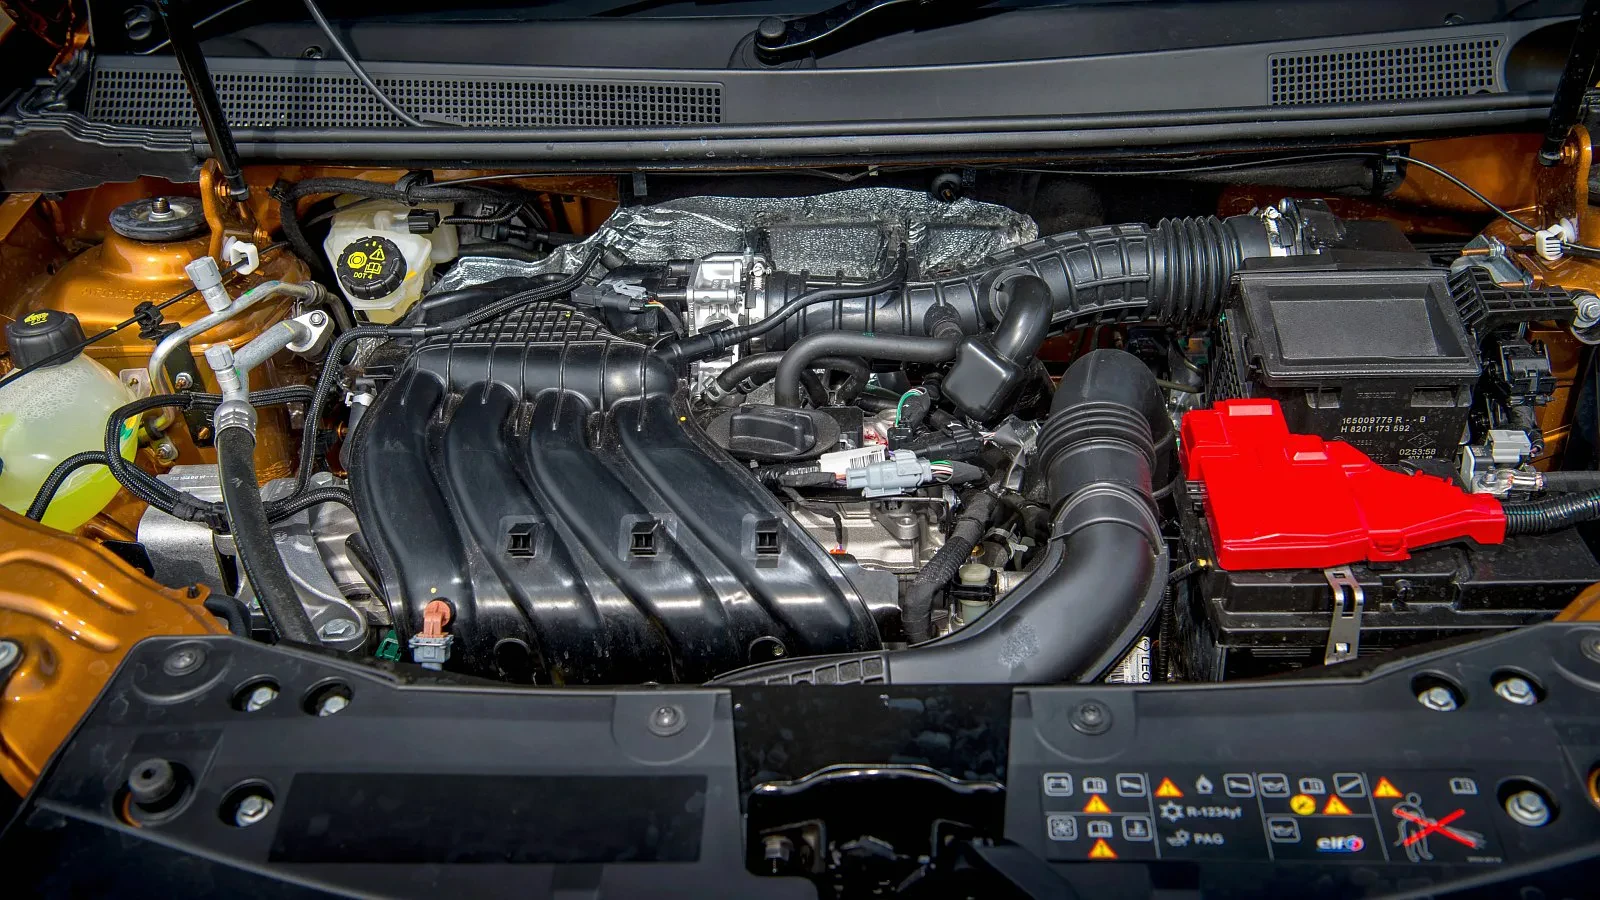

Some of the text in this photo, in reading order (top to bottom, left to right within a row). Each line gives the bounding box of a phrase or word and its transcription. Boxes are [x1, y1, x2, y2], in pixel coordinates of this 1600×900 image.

[353, 271, 367, 279] DOT
[1340, 425, 1348, 433] H
[1350, 425, 1372, 433] 8201
[1393, 424, 1410, 432] 592
[1193, 832, 1225, 845] PAG
[1316, 836, 1345, 850] elf
